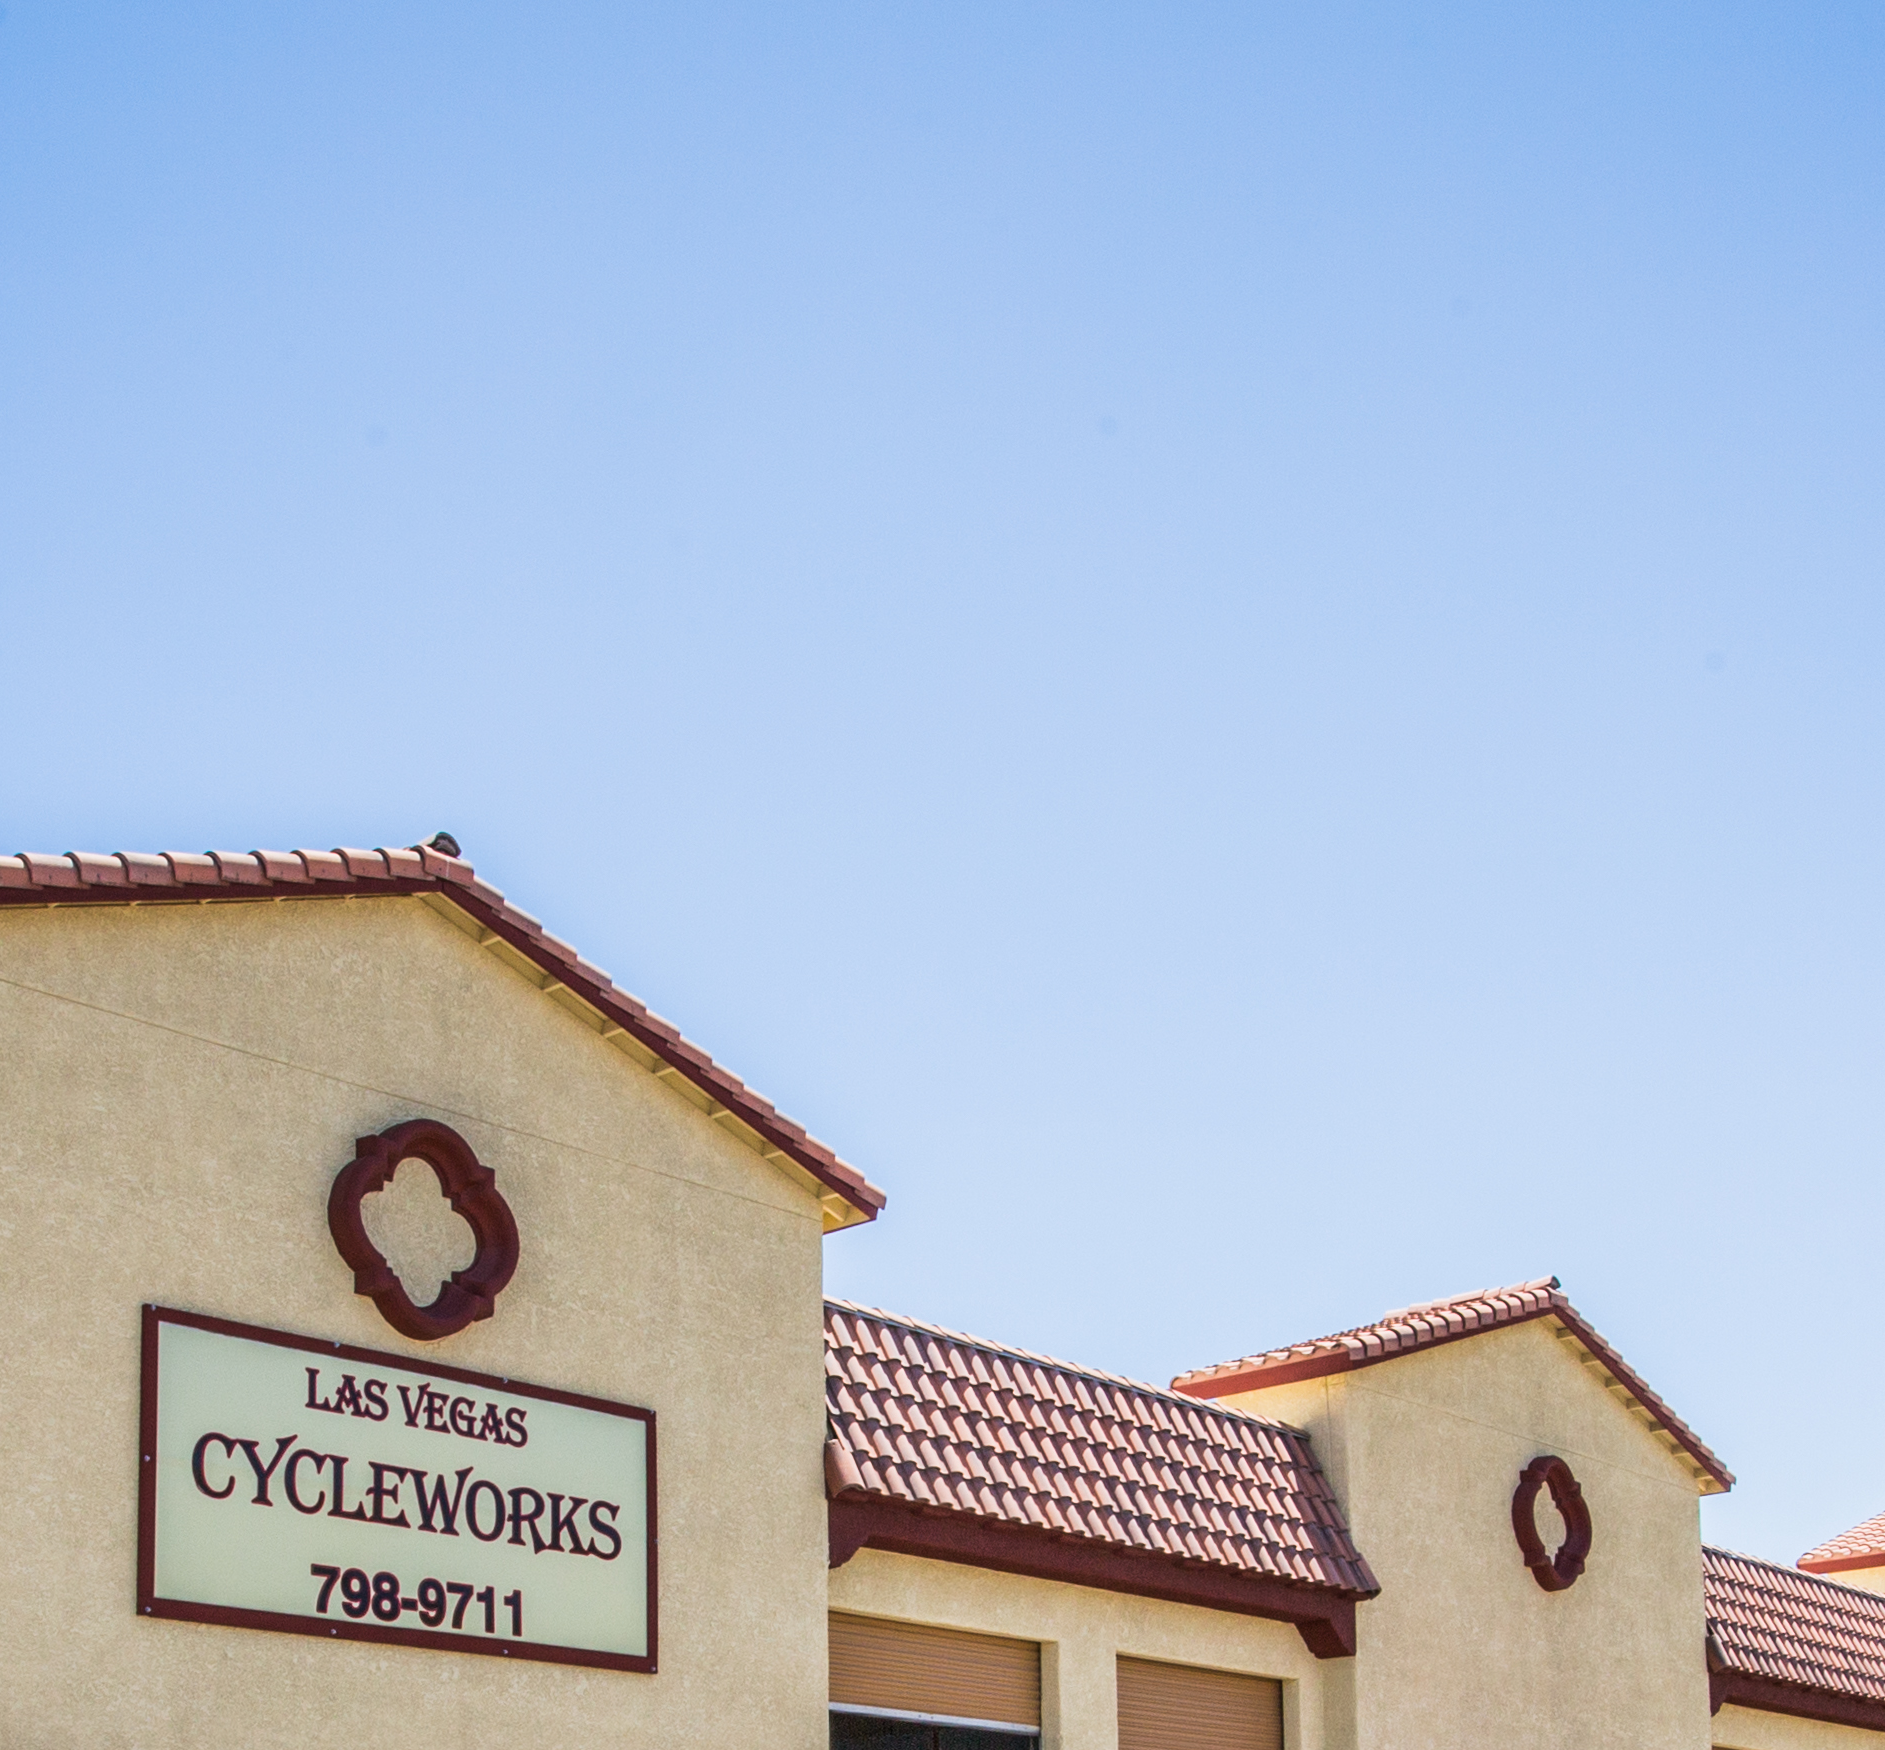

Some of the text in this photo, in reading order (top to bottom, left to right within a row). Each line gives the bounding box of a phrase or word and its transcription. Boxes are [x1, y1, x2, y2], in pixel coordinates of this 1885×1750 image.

[305, 1367, 529, 1448] LAS VEGAS
[191, 1431, 623, 1561] CYCLEWORKS
[310, 1563, 523, 1638] 798-9711
